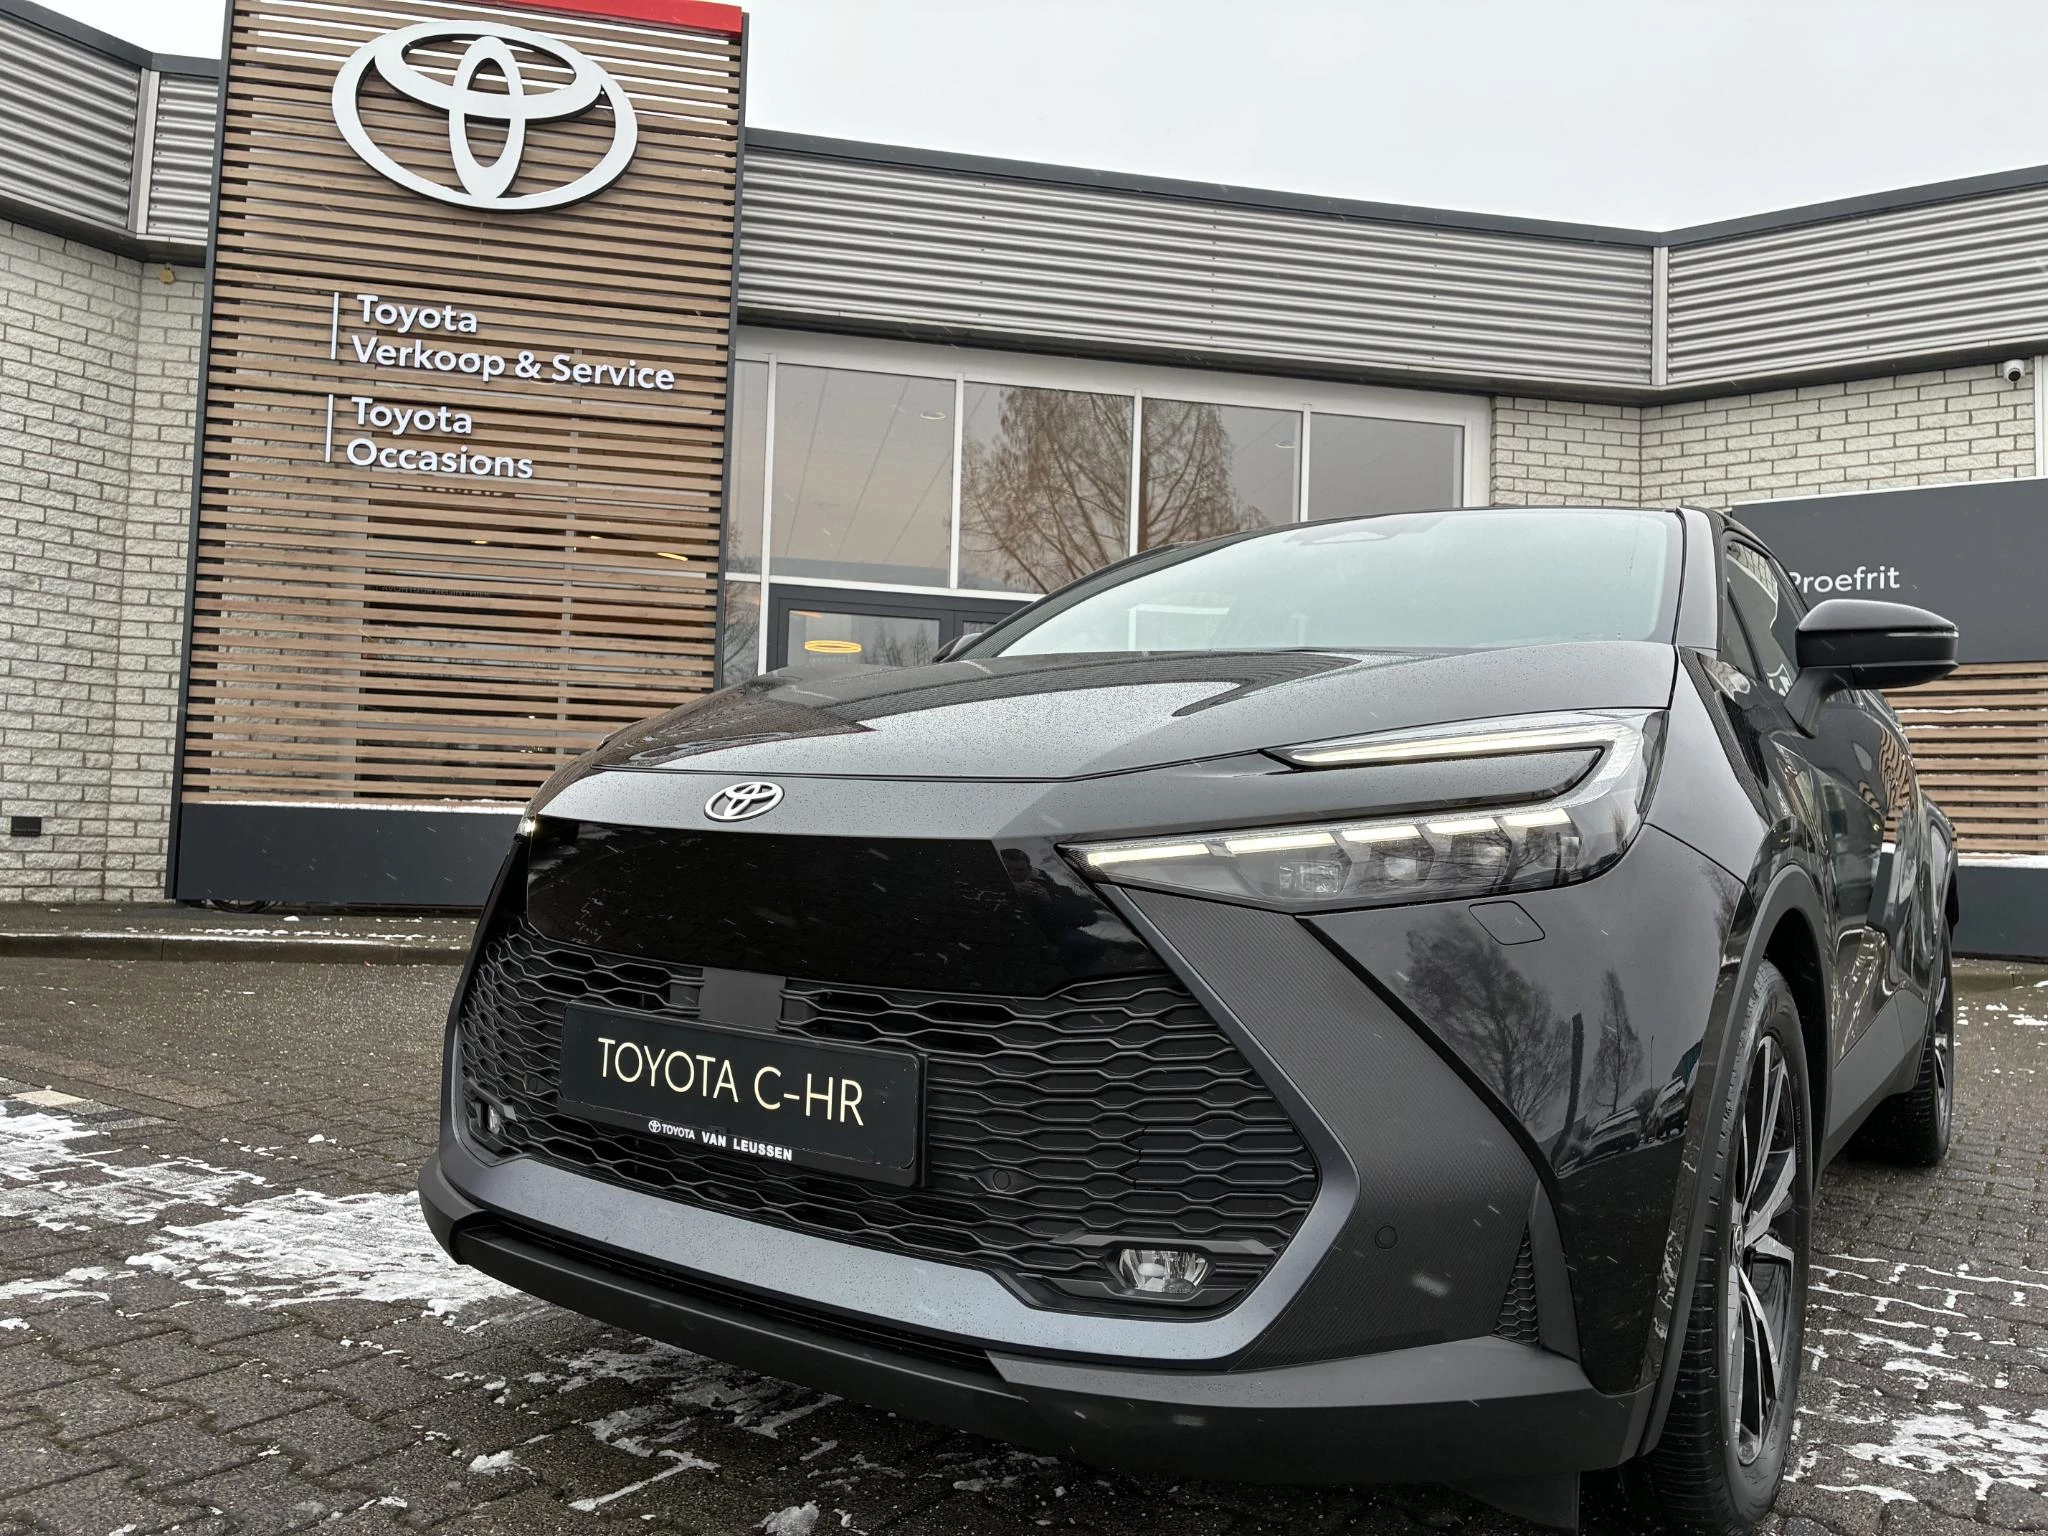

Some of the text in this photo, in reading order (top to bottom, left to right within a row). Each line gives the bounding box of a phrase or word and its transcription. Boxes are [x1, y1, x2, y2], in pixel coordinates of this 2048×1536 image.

[357, 294, 478, 334] Toyota
[351, 335, 675, 390] Verkoop & Service
[351, 396, 472, 435] Toyota
[346, 438, 533, 479] Occasions
[597, 1037, 864, 1126] TOYOTA C-HR
[662, 1123, 793, 1161] TOYOTA VAN LEUSSEN
